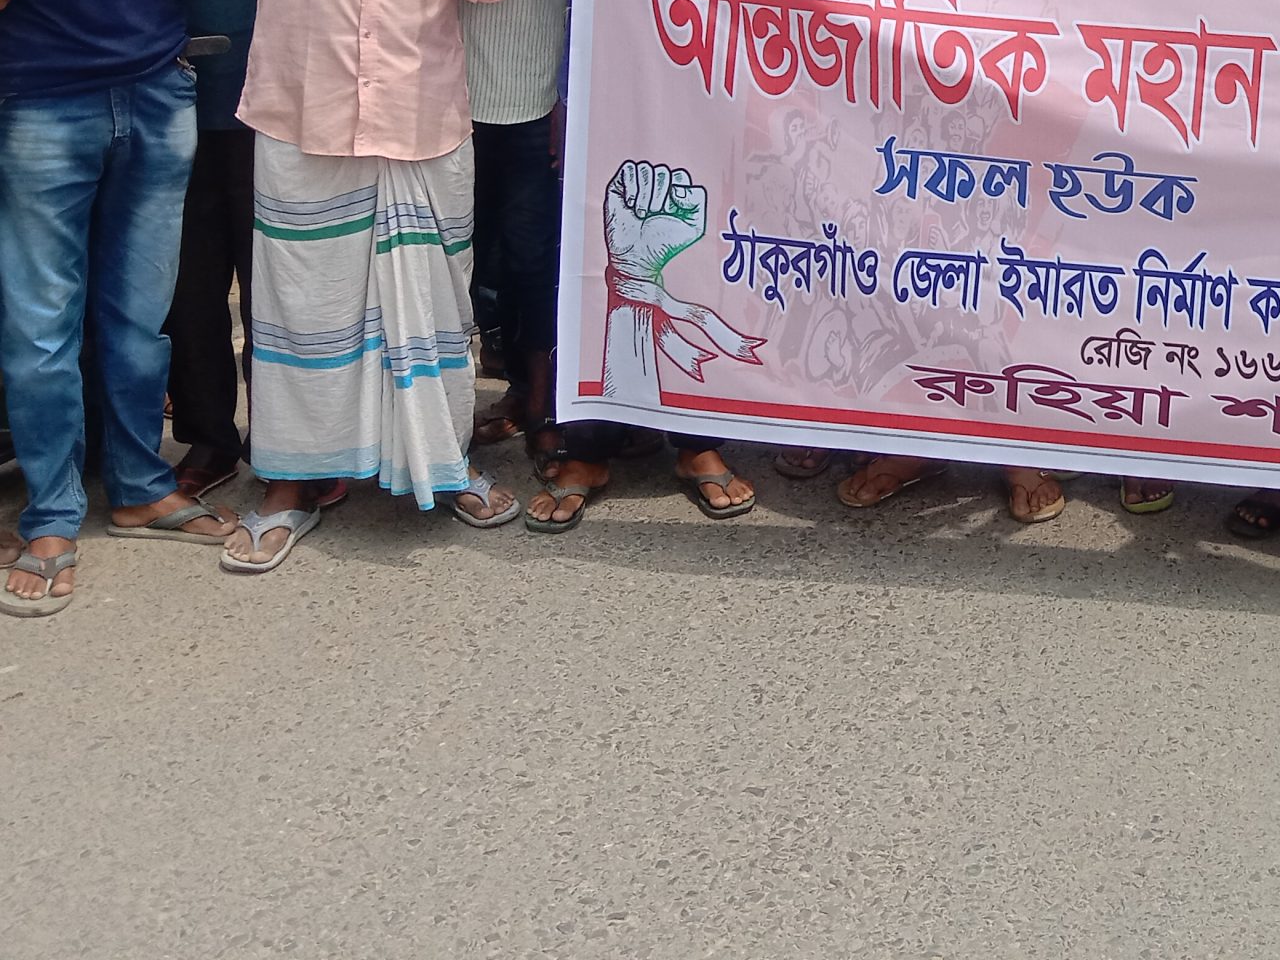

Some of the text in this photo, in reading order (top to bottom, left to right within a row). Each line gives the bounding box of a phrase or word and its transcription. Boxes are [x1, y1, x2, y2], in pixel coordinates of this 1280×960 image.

[1077, 19, 1278, 149] মহান
[875, 137, 1197, 220] সফল হউক
[723, 210, 878, 311] ঠাকুরগাঁও
[893, 250, 987, 311] জেলা
[997, 238, 1123, 318] ইমারত
[1134, 249, 1237, 330] নির্মাণ
[1081, 328, 1155, 370] রেজি
[1165, 342, 1201, 378] নং
[906, 364, 1192, 428] রুহিয়া
